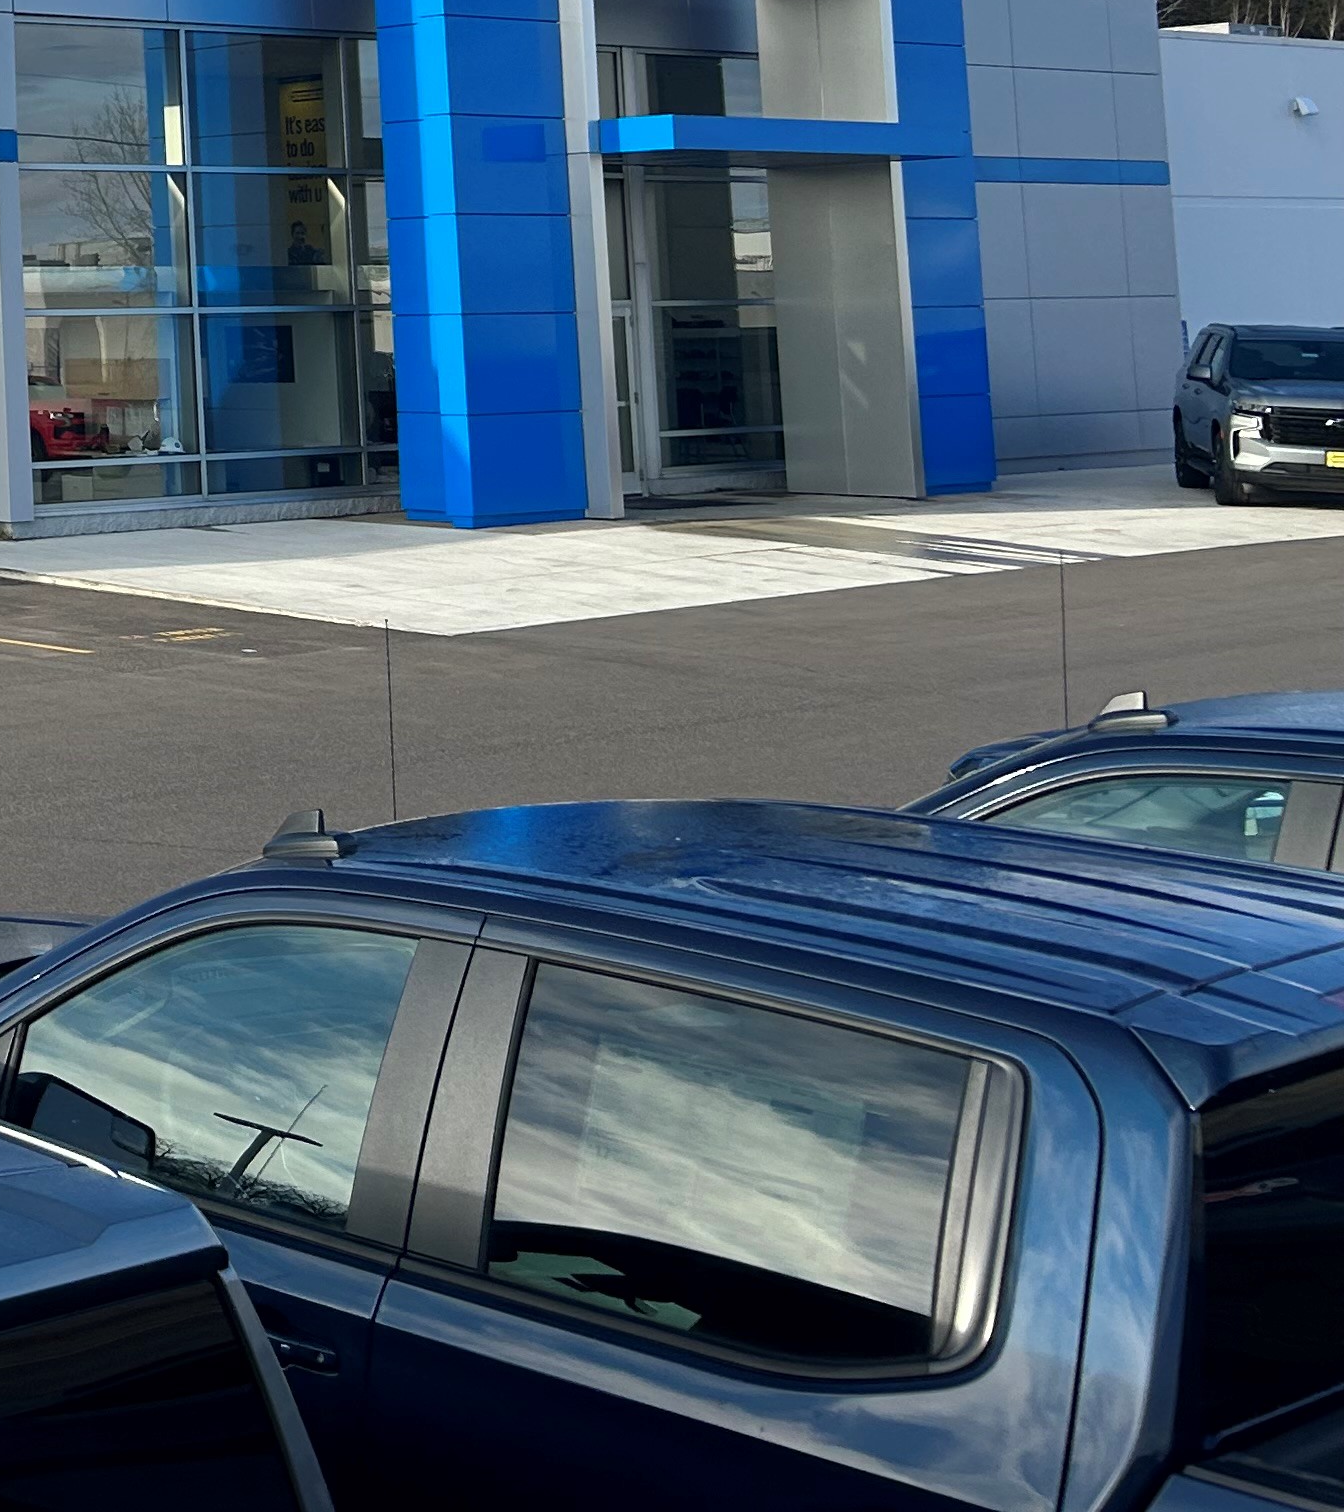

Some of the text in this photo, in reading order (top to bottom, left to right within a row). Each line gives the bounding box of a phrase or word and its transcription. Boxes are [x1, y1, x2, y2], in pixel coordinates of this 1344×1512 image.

[285, 116, 302, 135] It's
[287, 138, 315, 158] to do
